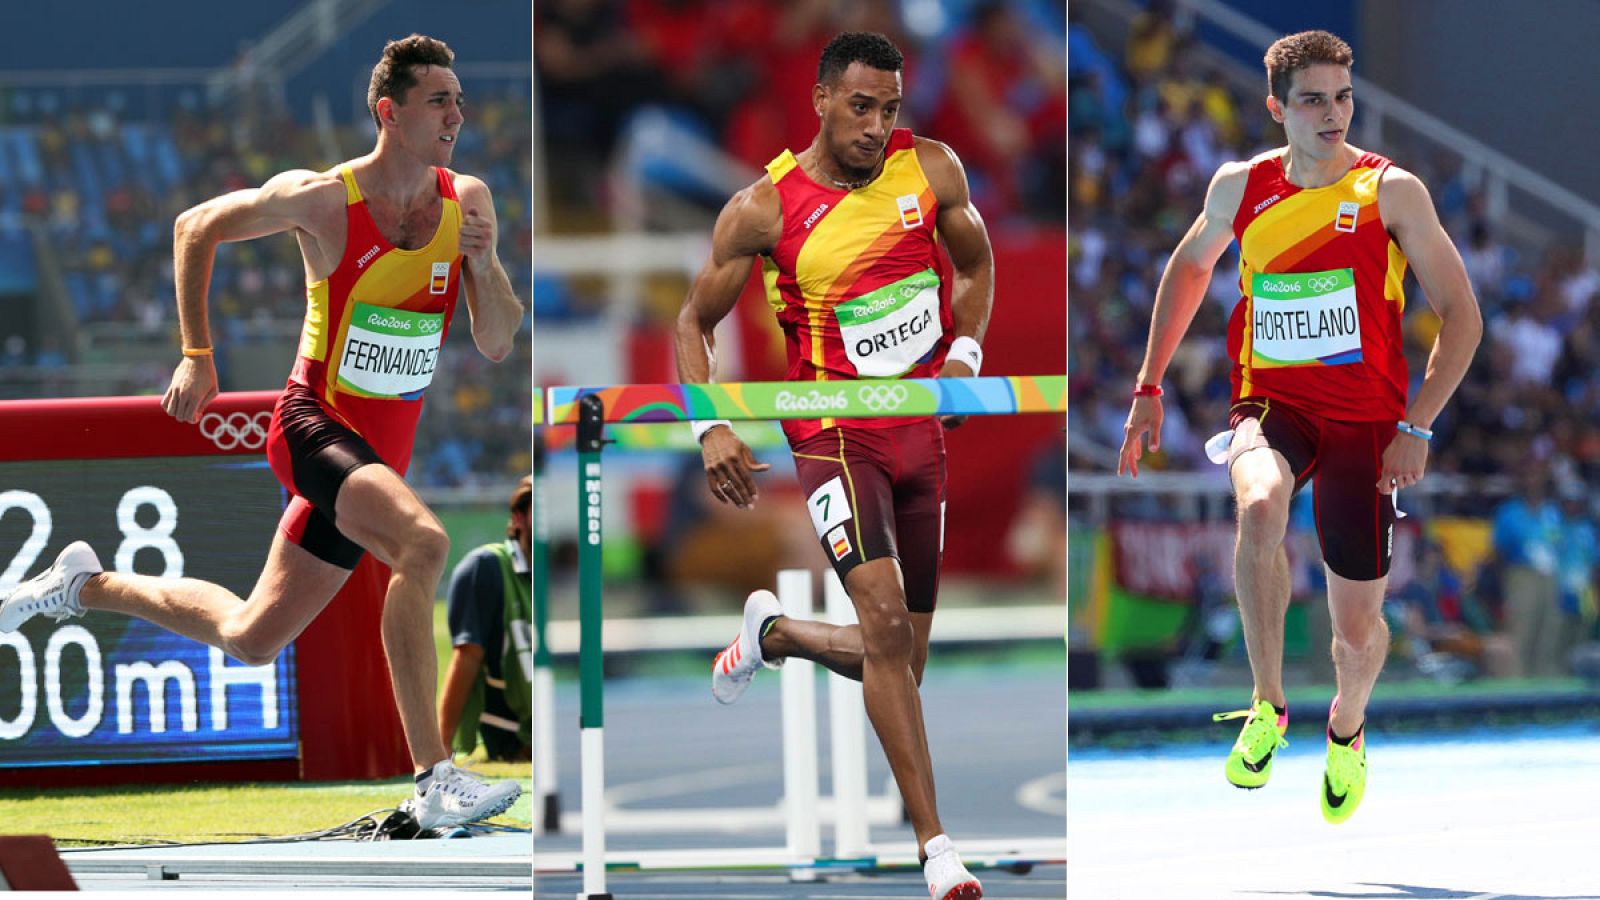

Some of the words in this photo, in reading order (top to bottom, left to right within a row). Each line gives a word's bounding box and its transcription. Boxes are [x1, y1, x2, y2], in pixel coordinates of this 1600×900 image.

[855, 308, 933, 358] ORTEGA
[1255, 305, 1357, 341] HORTELANO
[775, 389, 849, 411] Rio2016
[586, 480, 600, 545] MONDO
[815, 493, 831, 522] 7
